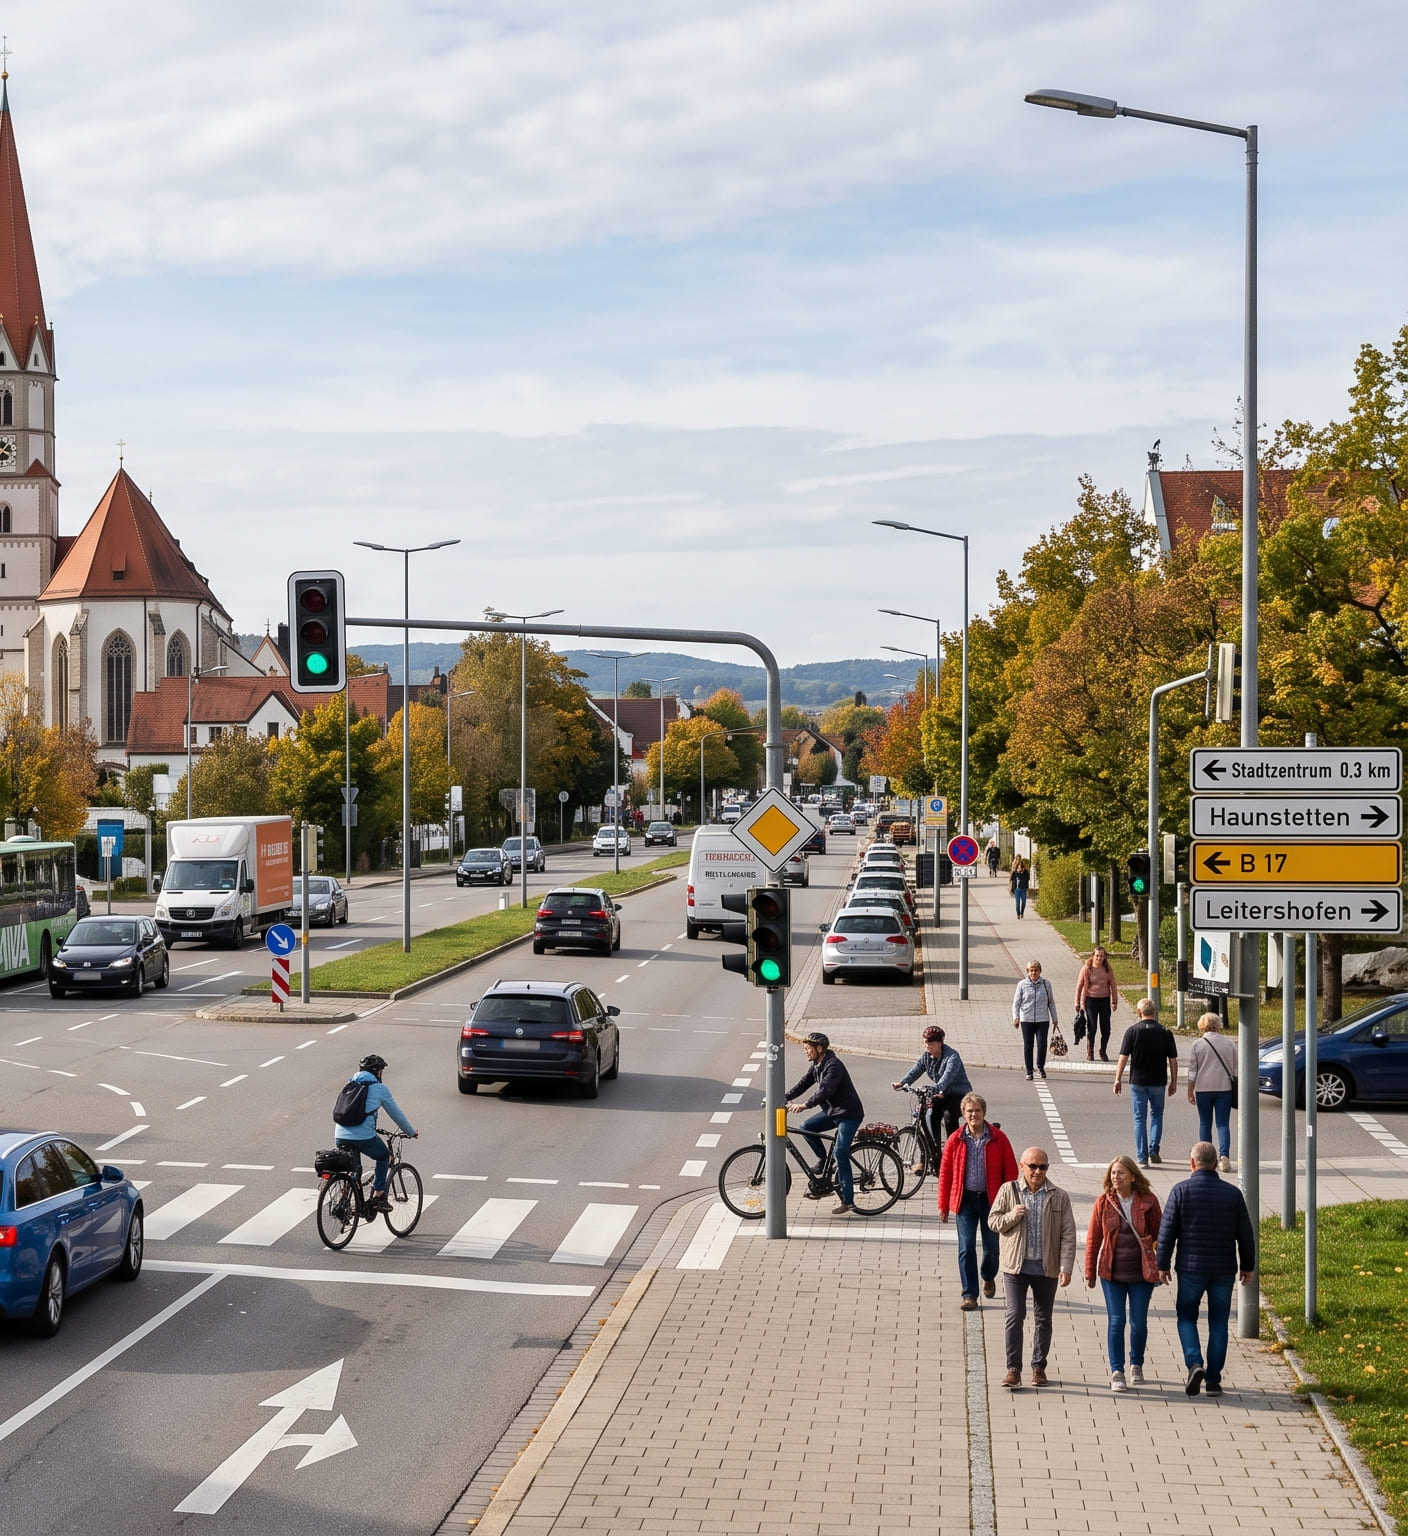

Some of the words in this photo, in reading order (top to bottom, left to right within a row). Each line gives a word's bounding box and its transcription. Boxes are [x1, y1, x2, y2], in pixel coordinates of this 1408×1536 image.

[1232, 762, 1332, 778] Stadtzentrum
[1340, 762, 1362, 778] 0.3
[1368, 762, 1391, 778] km
[1210, 807, 1350, 826] Haunstetten
[1241, 854, 1256, 873] B
[1264, 854, 1287, 873] 17
[1206, 899, 1351, 920] Leitershofen
